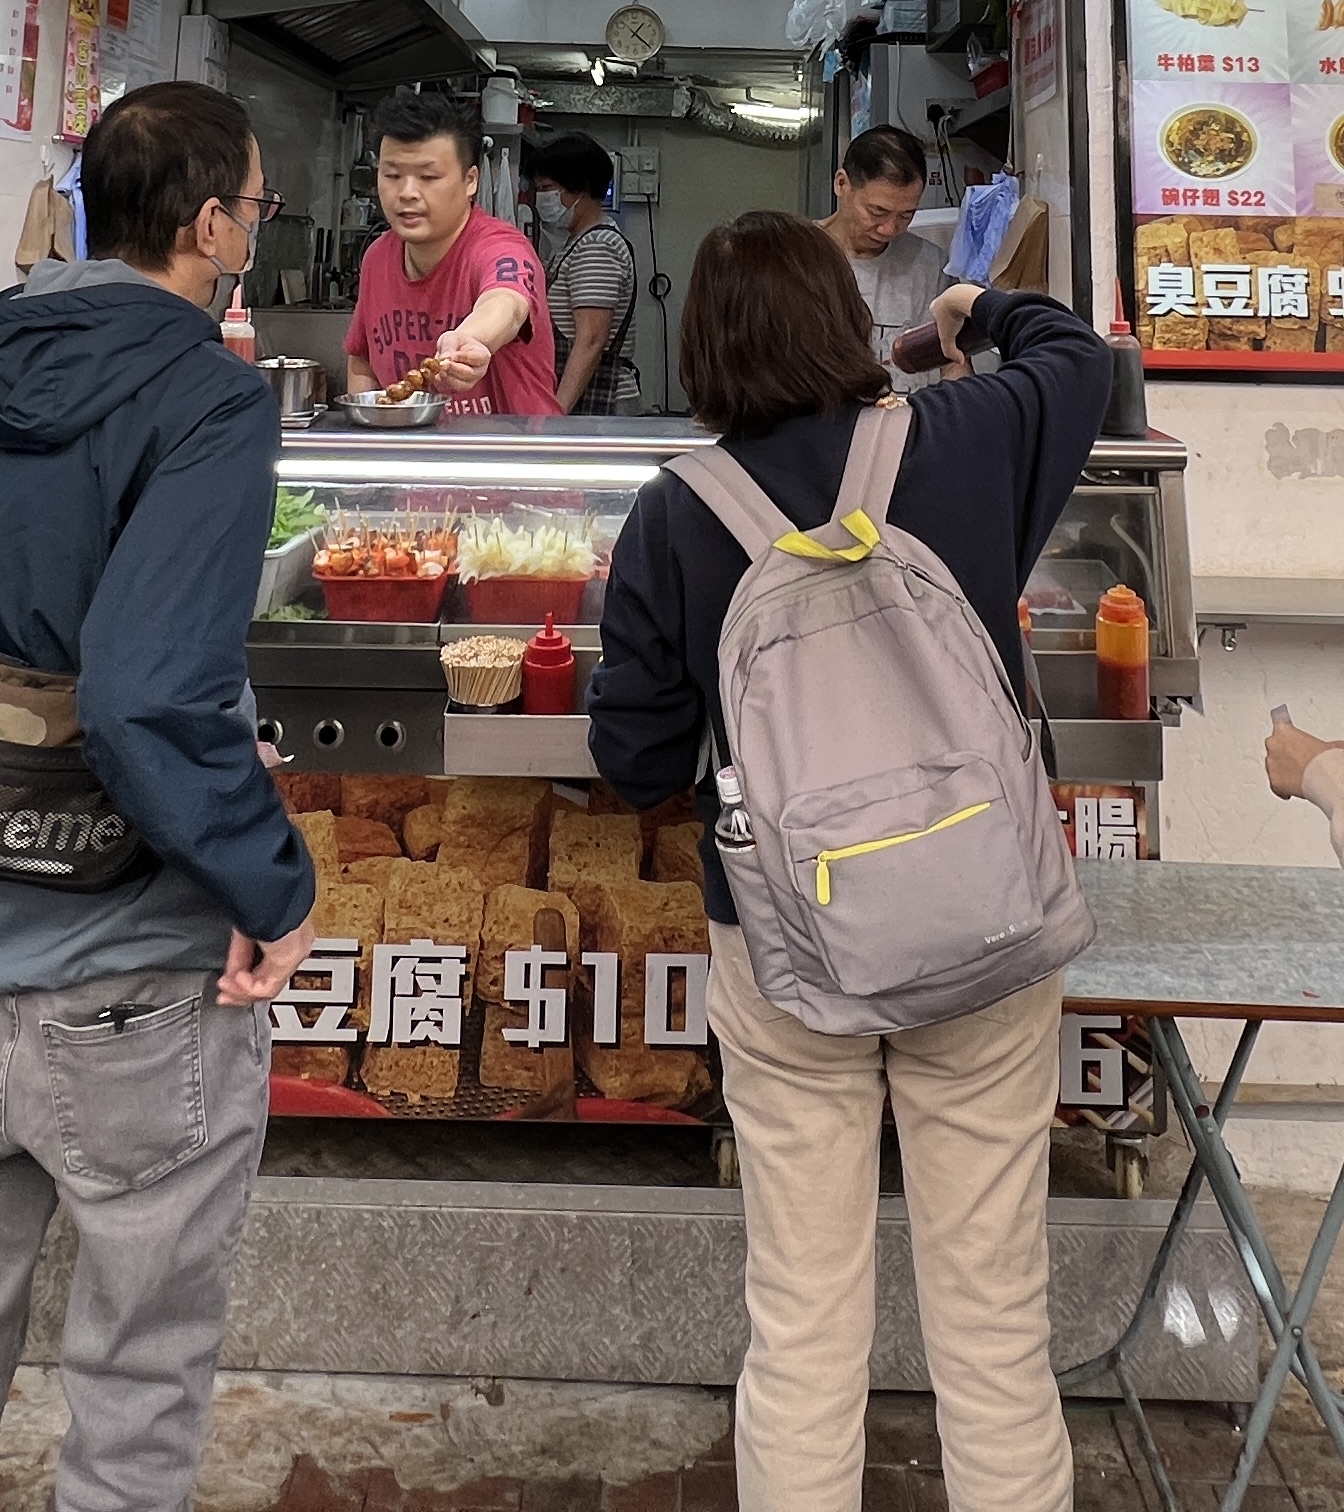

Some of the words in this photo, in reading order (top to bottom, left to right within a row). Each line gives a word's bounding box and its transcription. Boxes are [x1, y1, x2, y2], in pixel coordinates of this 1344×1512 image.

[1222, 56, 1261, 74] $13
[1227, 189, 1266, 208] $22
[1146, 262, 1310, 318] 臭豆腐
[271, 938, 467, 1045] 豆腐
[502, 944, 709, 1048] $10
